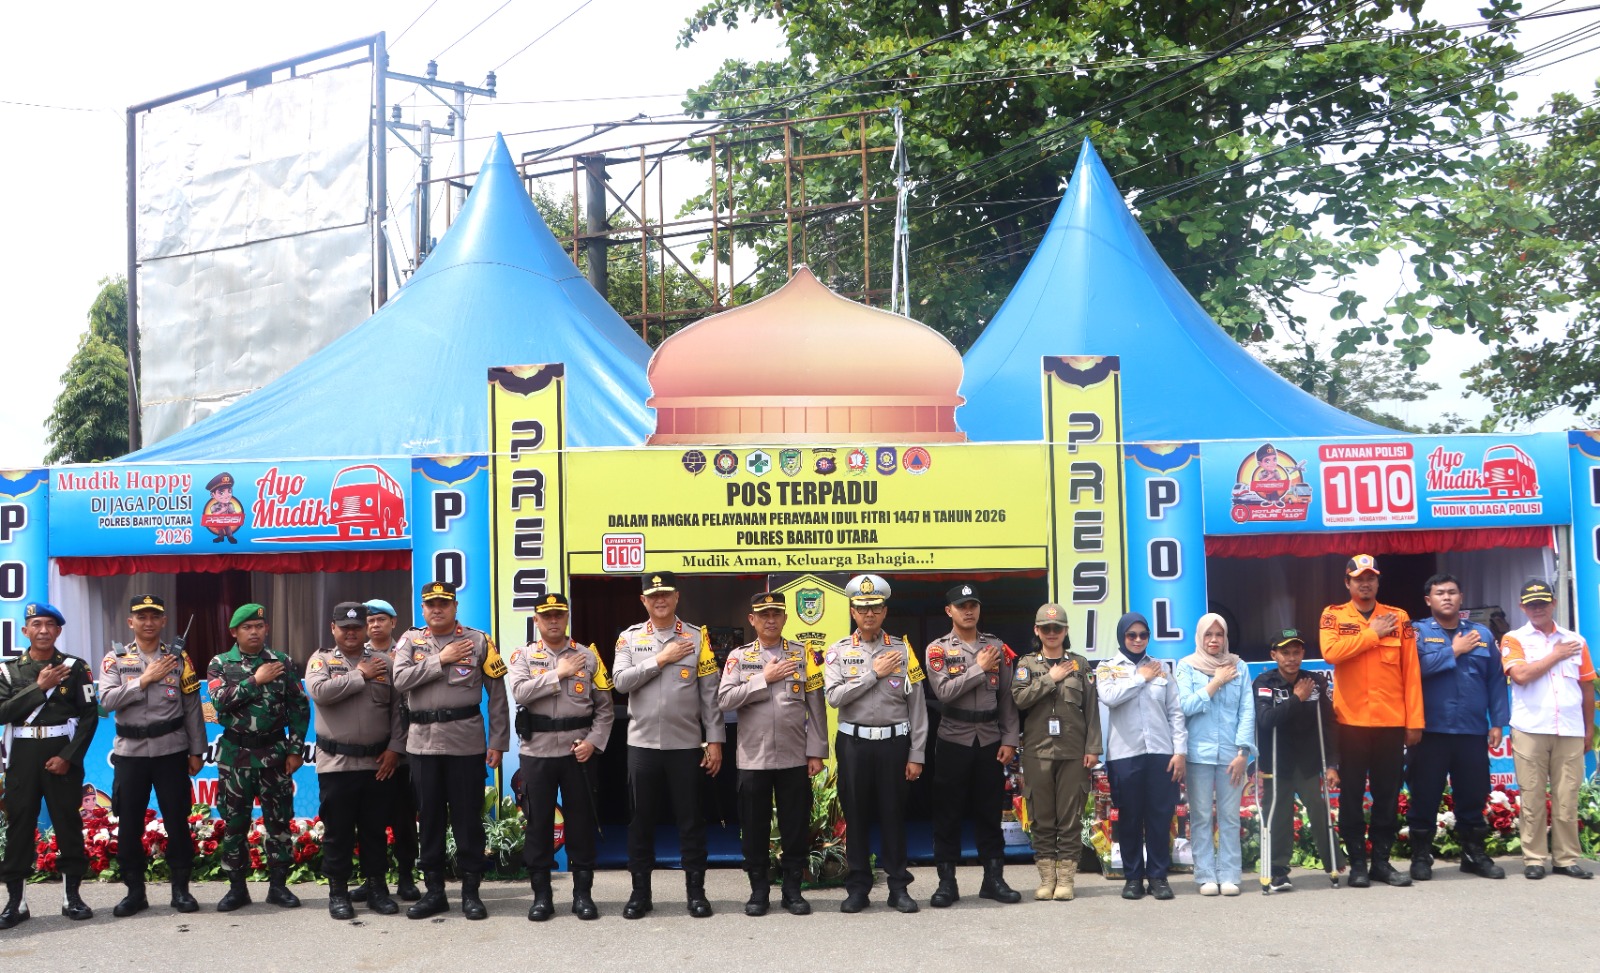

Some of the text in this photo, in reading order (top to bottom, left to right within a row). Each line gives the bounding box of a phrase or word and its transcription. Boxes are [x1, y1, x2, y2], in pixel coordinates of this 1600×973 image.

[1325, 446, 1407, 459] LAYANAN POLISI
[1427, 446, 1465, 473] Ayo
[58, 470, 192, 494] Mudik Happy
[256, 467, 306, 504] Ayo
[1329, 470, 1411, 508] 110
[1426, 469, 1484, 490] Mudik
[727, 480, 878, 506] POS TERPADU
[91, 495, 192, 515] DI JAGA POLISI
[251, 499, 331, 528] Mudik
[1433, 503, 1541, 516] MUDIK DIJAGA POLISI
[99, 515, 192, 527] POLRES BARITO UTARA
[205, 516, 242, 524] PRESISI
[608, 509, 1006, 527] DALAM RANGKA PELAYANAN PERAYAAN IDUL FITRI 1447 H TAHUN 2026
[156, 529, 192, 544] 2026
[510, 421, 548, 645] PRESI
[737, 529, 878, 545] POLRES BARITO UTARA
[1068, 412, 1107, 672] PRESI
[608, 547, 640, 563] 110
[683, 552, 934, 568] Mudik Aman, Keluarga Bahagia...!
[1146, 478, 1183, 674] POL
